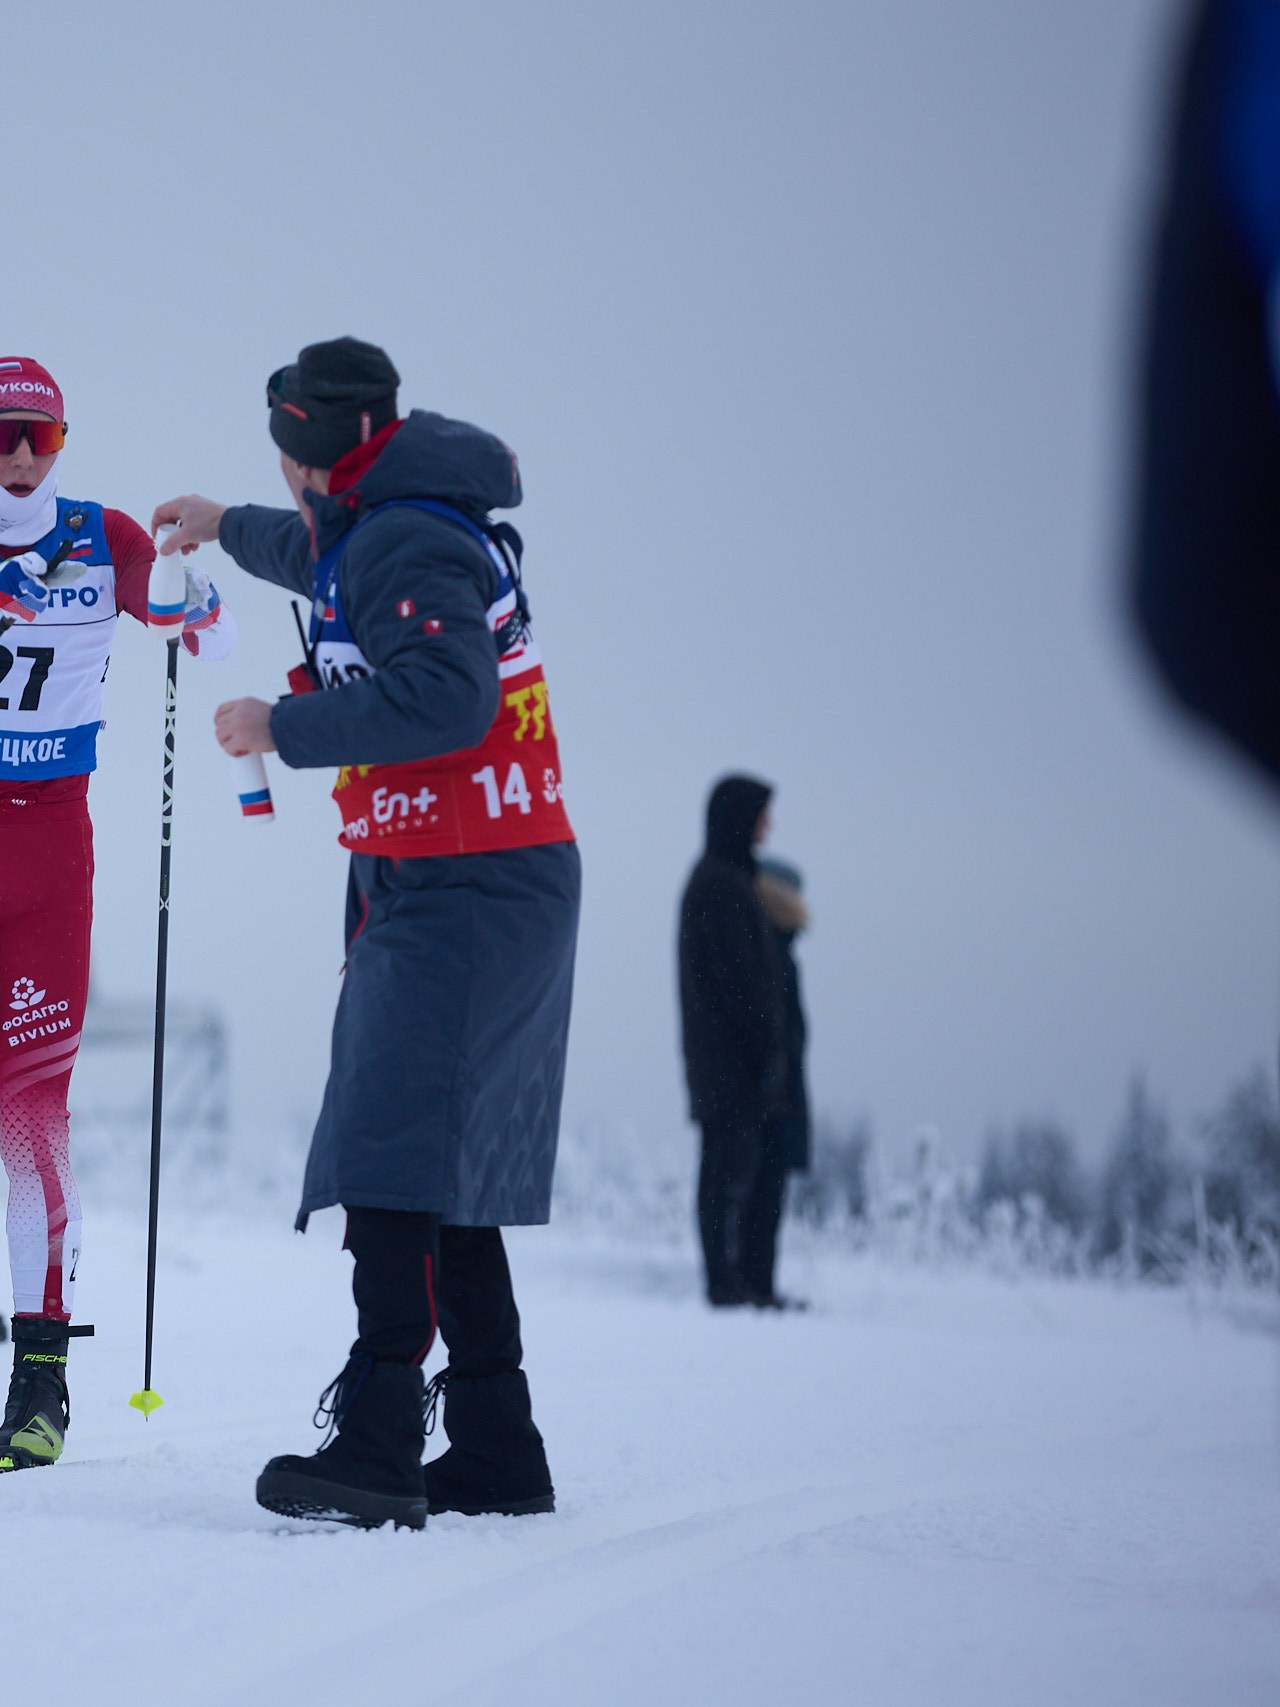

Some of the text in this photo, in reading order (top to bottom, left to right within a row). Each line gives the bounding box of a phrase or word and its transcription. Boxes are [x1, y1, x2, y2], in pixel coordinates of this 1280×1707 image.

[372, 787, 438, 824] En+
[472, 762, 532, 818] 14
[2, 1000, 69, 1031] ФОСАГРО
[8, 1018, 71, 1047] BIVIUM
